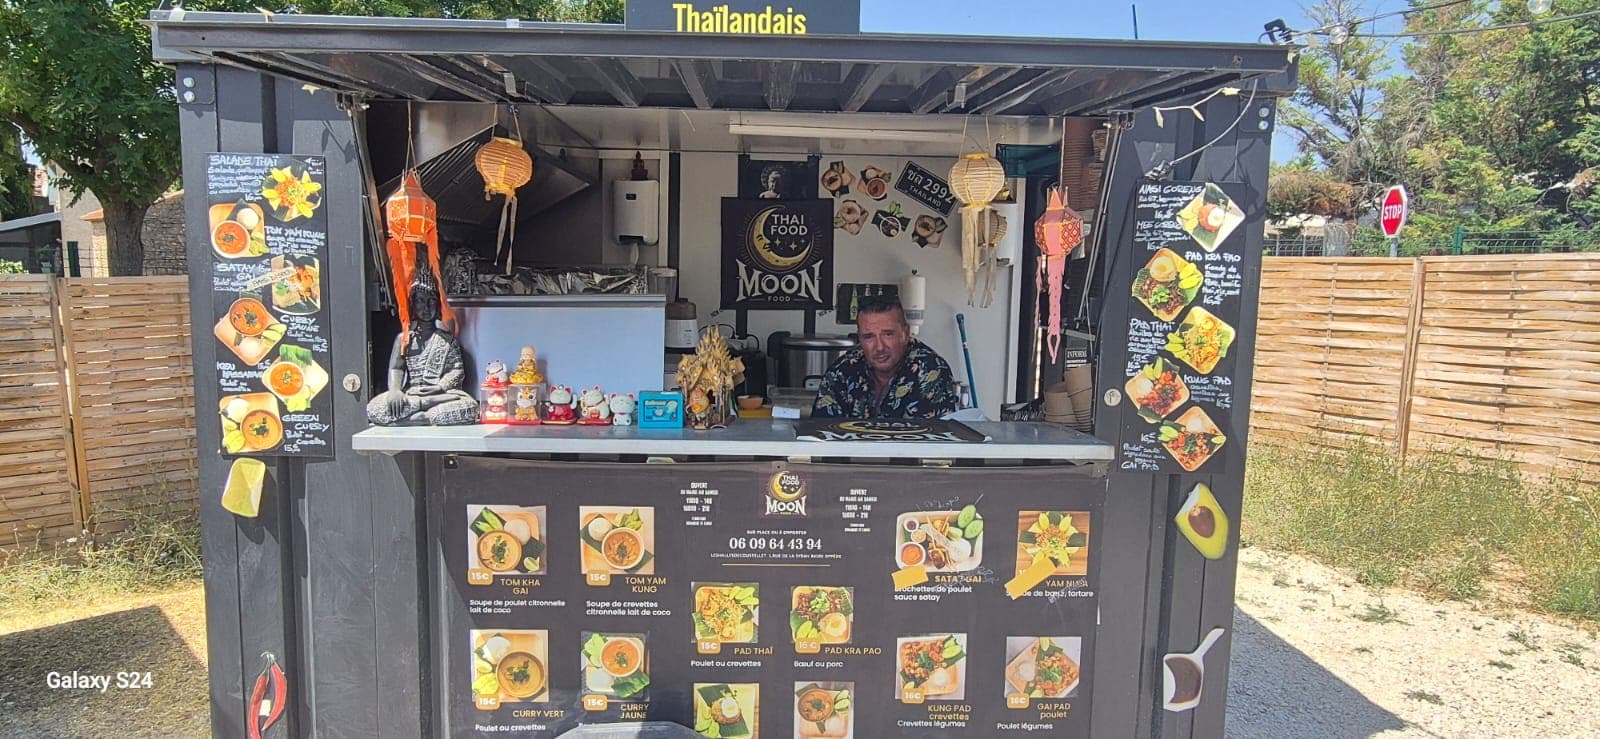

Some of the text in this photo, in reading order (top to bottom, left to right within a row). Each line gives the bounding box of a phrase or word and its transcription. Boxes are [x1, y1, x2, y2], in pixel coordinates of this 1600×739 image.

[672, 3, 807, 34] Thaïlandais
[1383, 204, 1402, 220] STOP
[772, 214, 804, 225] THAI
[771, 225, 808, 236] FOOD
[736, 258, 824, 303] MOON
[281, 414, 320, 422] GREEN
[765, 494, 808, 515] MOON
[729, 537, 822, 550] 06 09 64 43 94
[500, 578, 541, 586] TOM KHA
[625, 576, 667, 585] TOM YAM
[1046, 579, 1064, 587] YAM
[512, 587, 529, 595] GAI
[631, 585, 658, 593] KUNG
[948, 585, 972, 594] poulet
[919, 594, 940, 602] satay
[469, 599, 492, 607] Soupe
[504, 599, 527, 607] poulet
[528, 599, 566, 607] citronnelle
[586, 600, 610, 608] Soupe
[623, 600, 658, 608] crevettes
[586, 608, 626, 616] citronnelle
[627, 608, 640, 616] lait
[640, 608, 650, 616] de
[734, 646, 774, 655] PAD THAÏ
[824, 647, 882, 655] PAD KRA PAO
[826, 660, 844, 669] porc
[620, 703, 649, 711] CURRY
[927, 704, 972, 712] KUNG PAD
[512, 710, 564, 718] CURRY VERT
[620, 711, 647, 719] JAUNE
[1040, 711, 1067, 720] poulet
[934, 719, 966, 728] légumes
[997, 722, 1054, 731] Poulet légumes
[475, 724, 546, 732] Poulet ou crevettes
